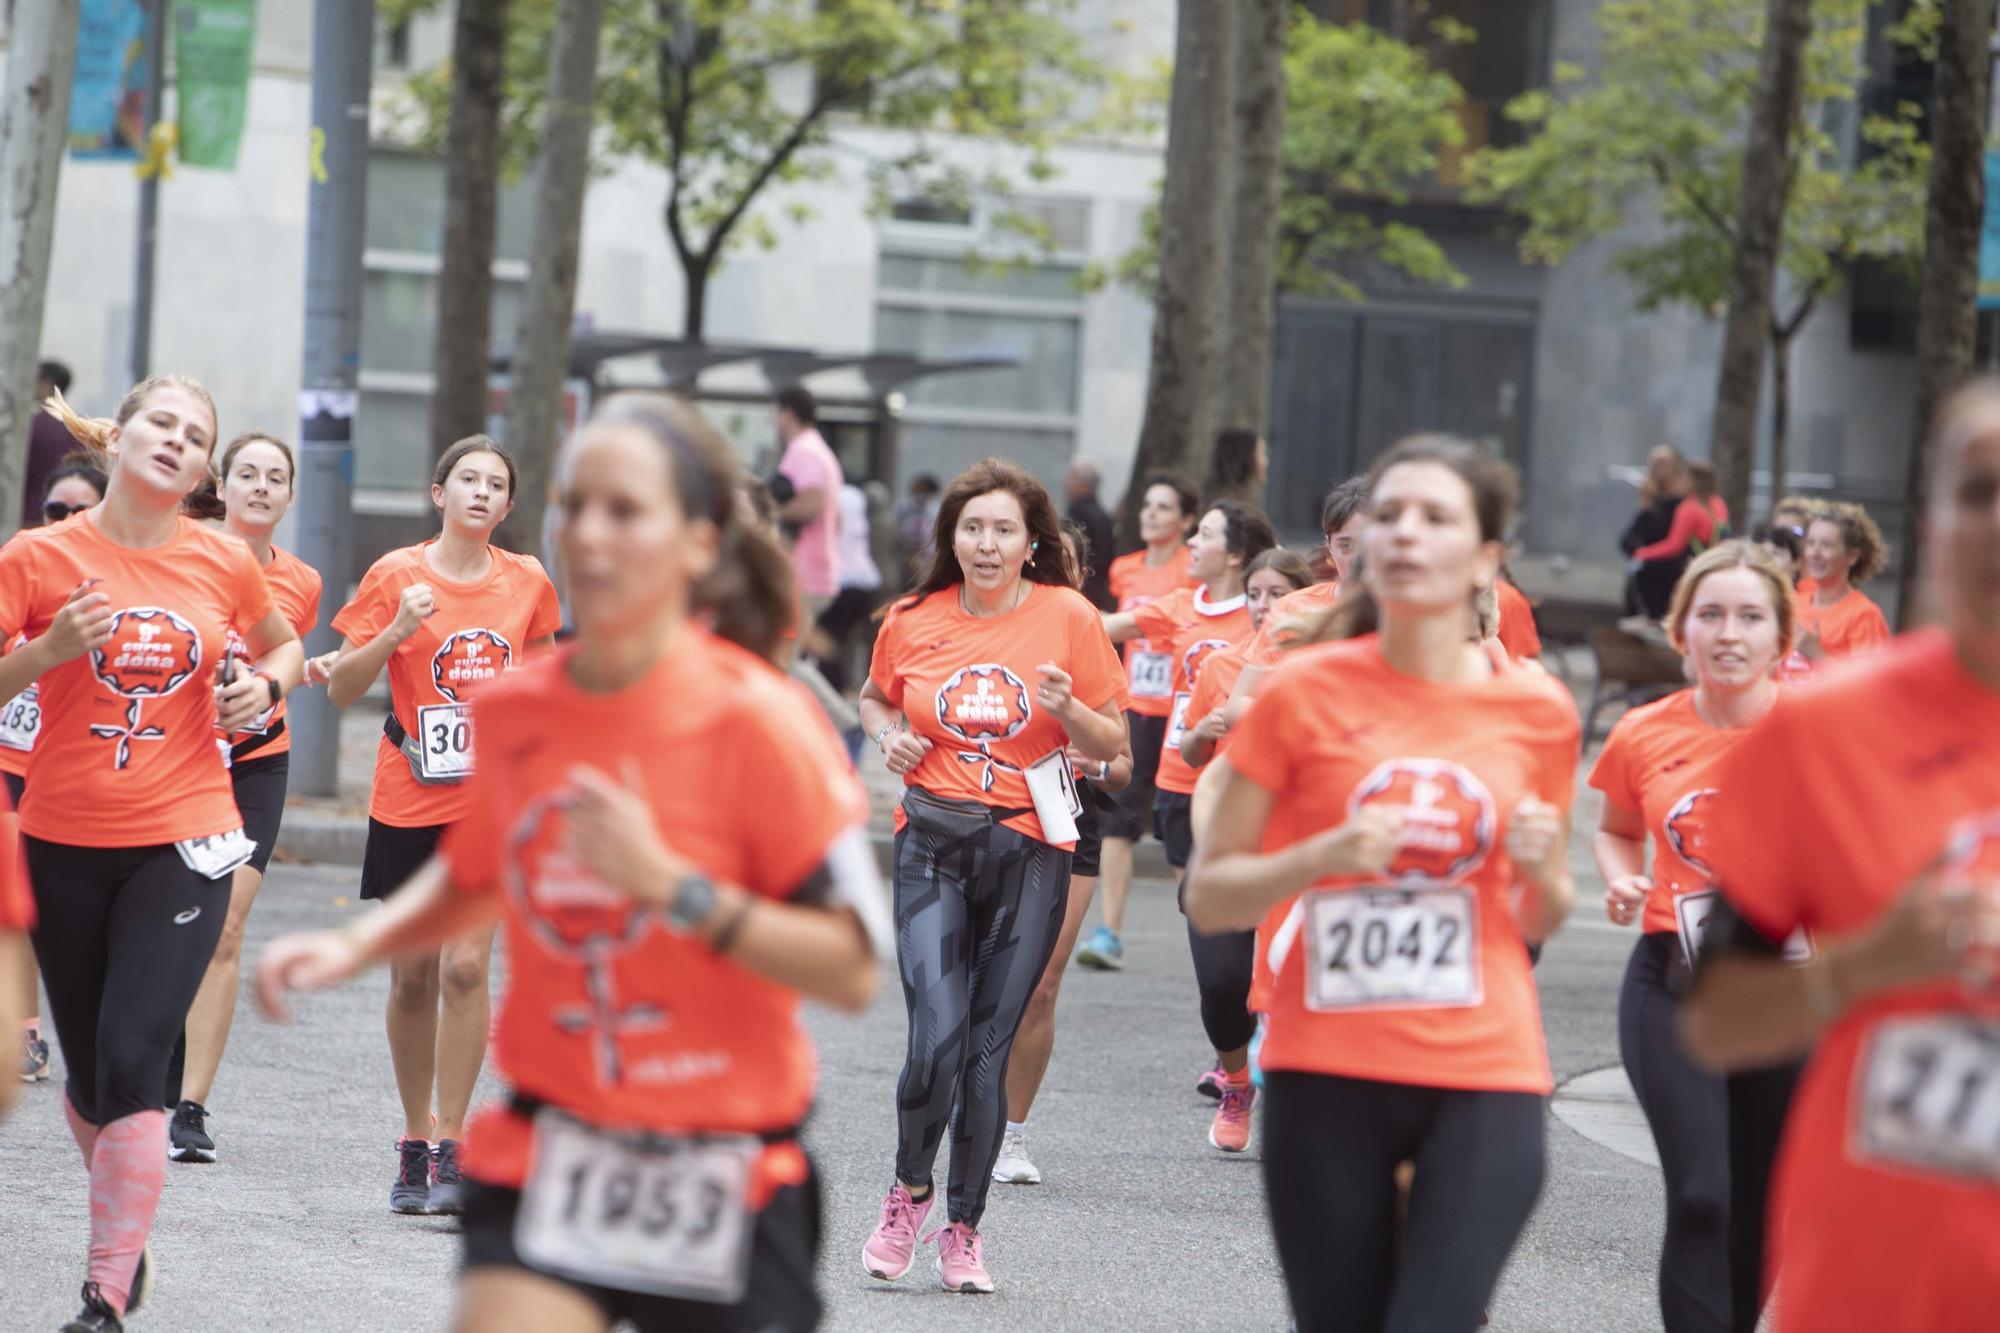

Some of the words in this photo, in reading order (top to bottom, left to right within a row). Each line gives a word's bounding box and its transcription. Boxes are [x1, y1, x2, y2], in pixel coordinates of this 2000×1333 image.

[121, 641, 173, 653] cursa
[112, 653, 175, 668] dona
[454, 656, 491, 667] cursa
[448, 667, 496, 681] dona
[962, 693, 1004, 706] cursa
[1, 702, 40, 732] 183
[955, 703, 1008, 721] dona
[1327, 914, 1459, 972] 2042
